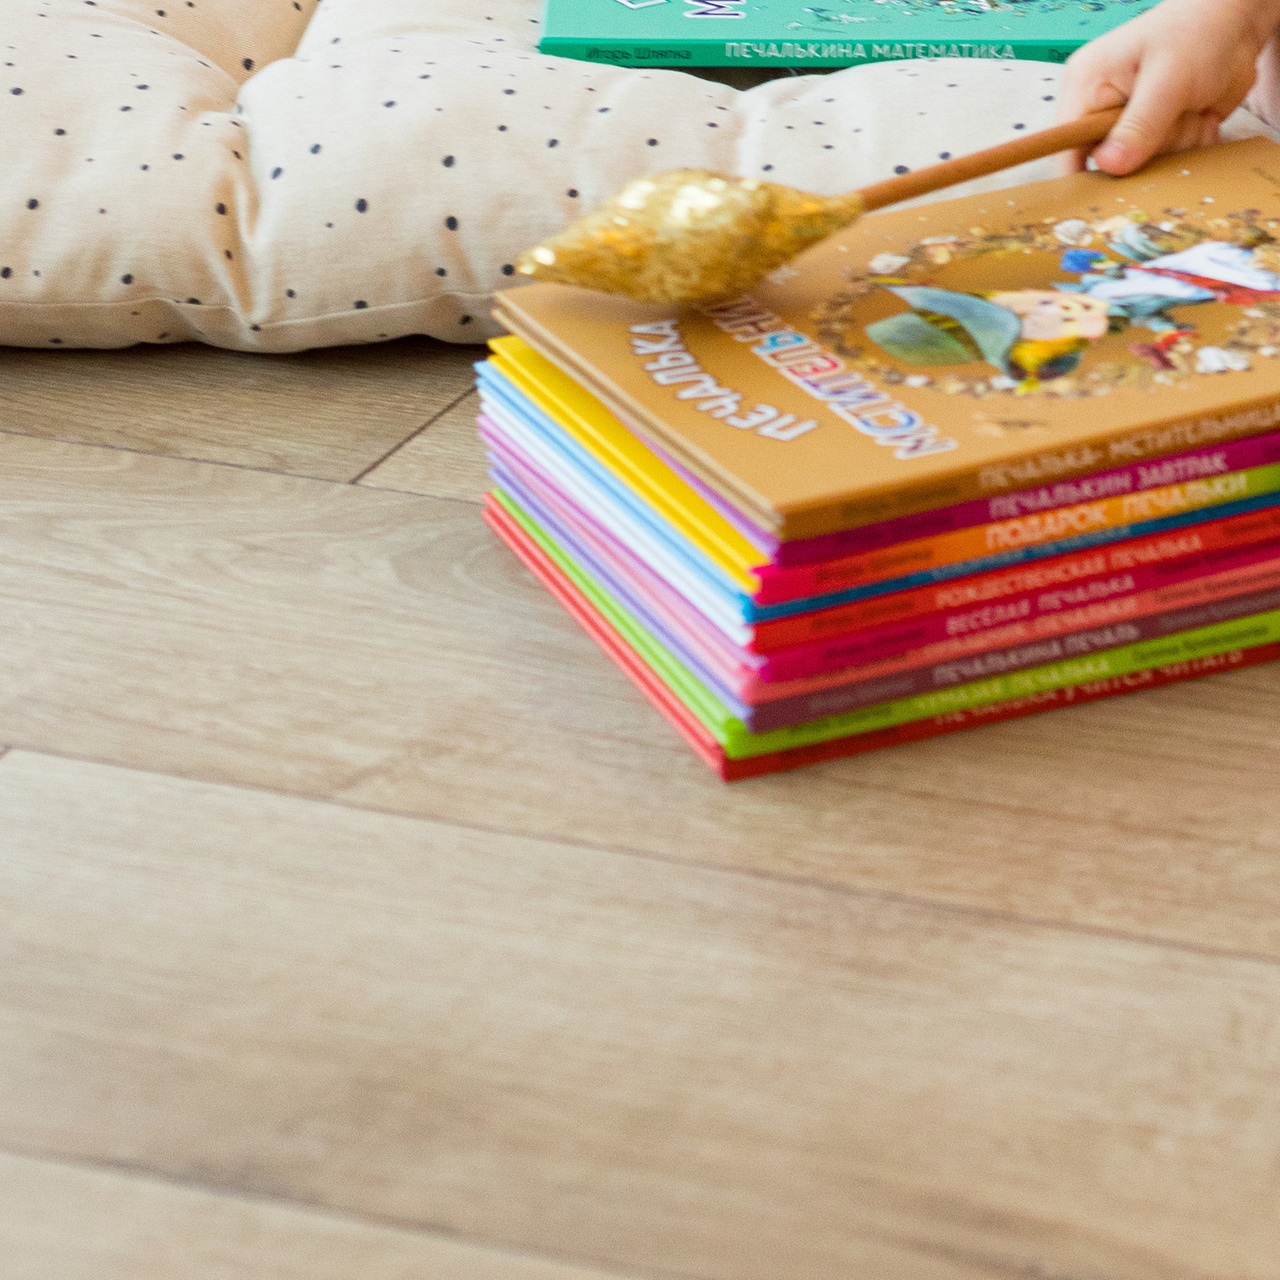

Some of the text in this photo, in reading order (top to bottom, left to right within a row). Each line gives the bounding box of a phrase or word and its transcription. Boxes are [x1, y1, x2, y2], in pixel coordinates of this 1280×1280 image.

[725, 42, 1016, 59] ПЕЧАЛЬКИНА МАТЕМАТИКА
[630, 318, 818, 441] ПЕЧАЛЬКА
[1137, 452, 1228, 488] ЗАВТРАК
[984, 503, 1108, 550] ПОДАРОК
[1121, 473, 1249, 519] ПЕЧАЛЬКИ
[1110, 533, 1203, 571] ПЕЧАЛЬКА
